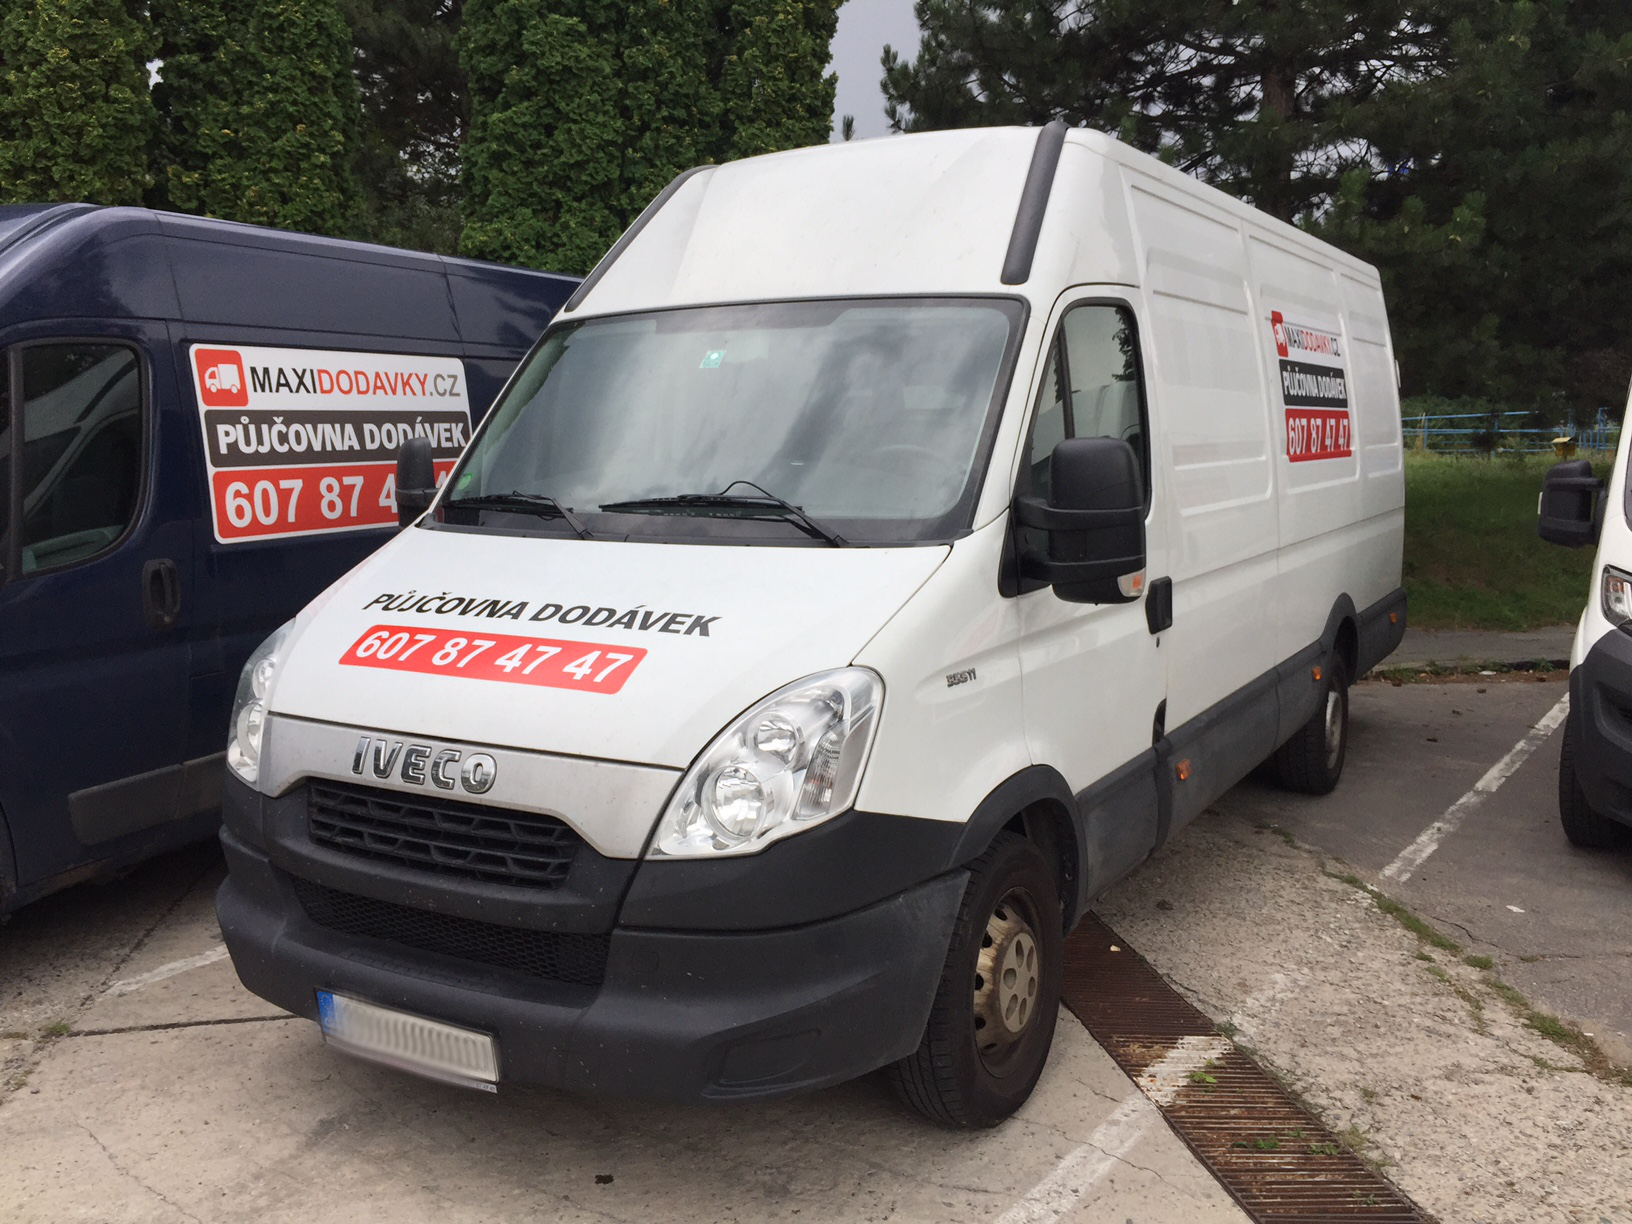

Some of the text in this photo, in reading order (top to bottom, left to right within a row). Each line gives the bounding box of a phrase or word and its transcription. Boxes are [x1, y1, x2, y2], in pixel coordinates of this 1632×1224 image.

[250, 366, 461, 398] MAXIDODAVKY.CZ
[216, 415, 467, 454] PŮJČOVNA DODÁVEK
[1288, 417, 1349, 455] 607 87 47 47
[225, 479, 303, 528] 607
[319, 476, 364, 519] 87
[362, 590, 722, 637] PŮJČOVNA DODÁVEK
[356, 630, 634, 683] 607 87 47 47
[350, 736, 498, 795] IVECO
